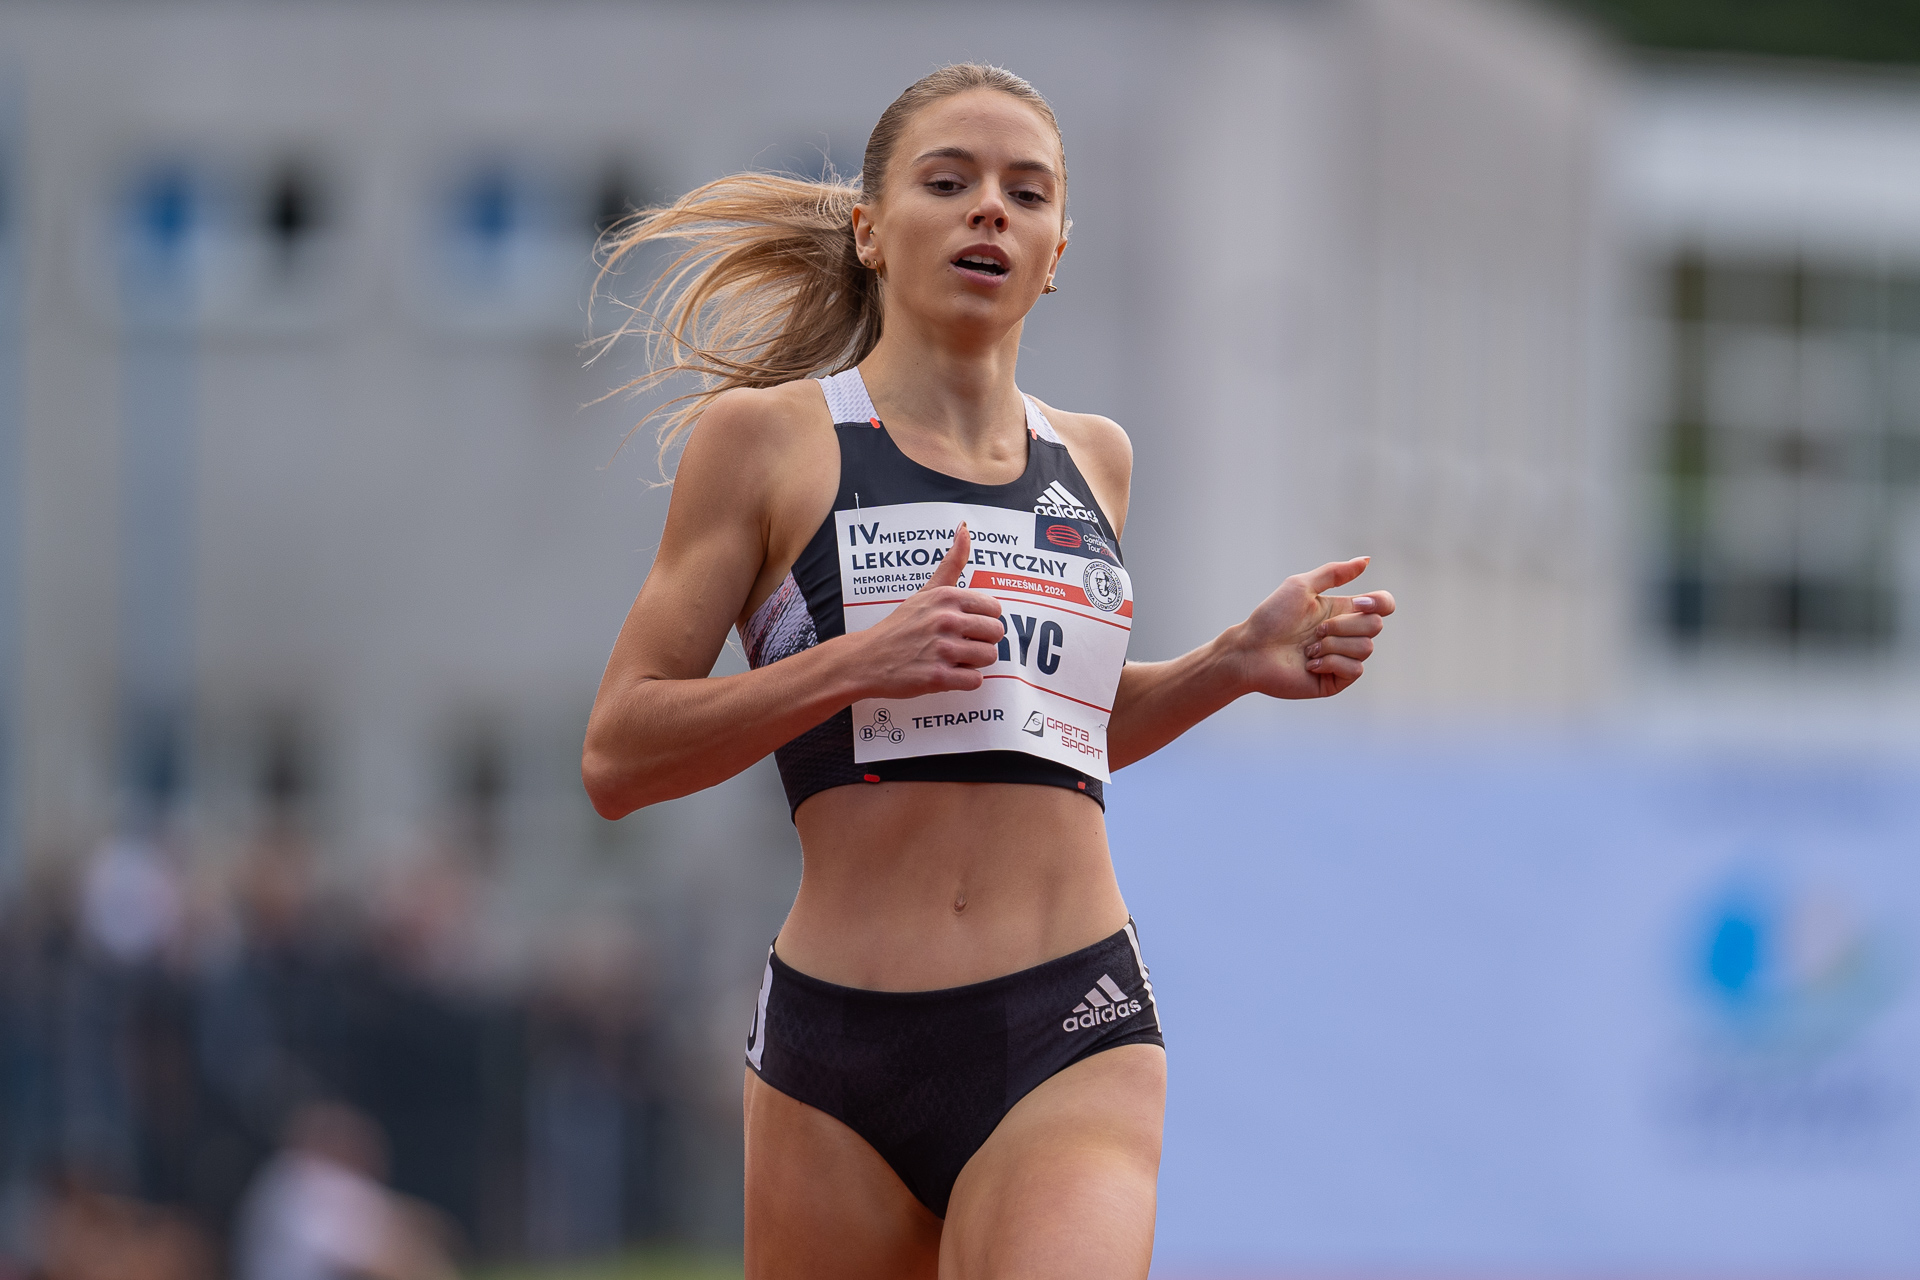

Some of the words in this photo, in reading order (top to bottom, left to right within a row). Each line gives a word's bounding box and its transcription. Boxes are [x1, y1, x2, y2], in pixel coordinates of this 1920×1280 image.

[1033, 503, 1098, 523] adidas
[849, 522, 880, 546] IV
[879, 529, 1018, 545] MIĘDZYNAODOWY
[1087, 543, 1101, 554] Tour
[852, 548, 1067, 578] LEKKOAETYCZNY
[853, 573, 908, 584] MEMORIAŁ
[909, 571, 965, 581] ZBIGA
[990, 576, 996, 585] 1
[996, 577, 1044, 593] WRZEŚNIA
[1044, 584, 1066, 597] 2024
[854, 581, 966, 595] LUDWICHOWO
[878, 710, 887, 722] S
[912, 709, 1004, 729] TETRAPUR
[863, 728, 873, 739] B
[891, 730, 902, 741] G
[1061, 736, 1103, 760] SPORT
[1063, 999, 1142, 1032] adidas
